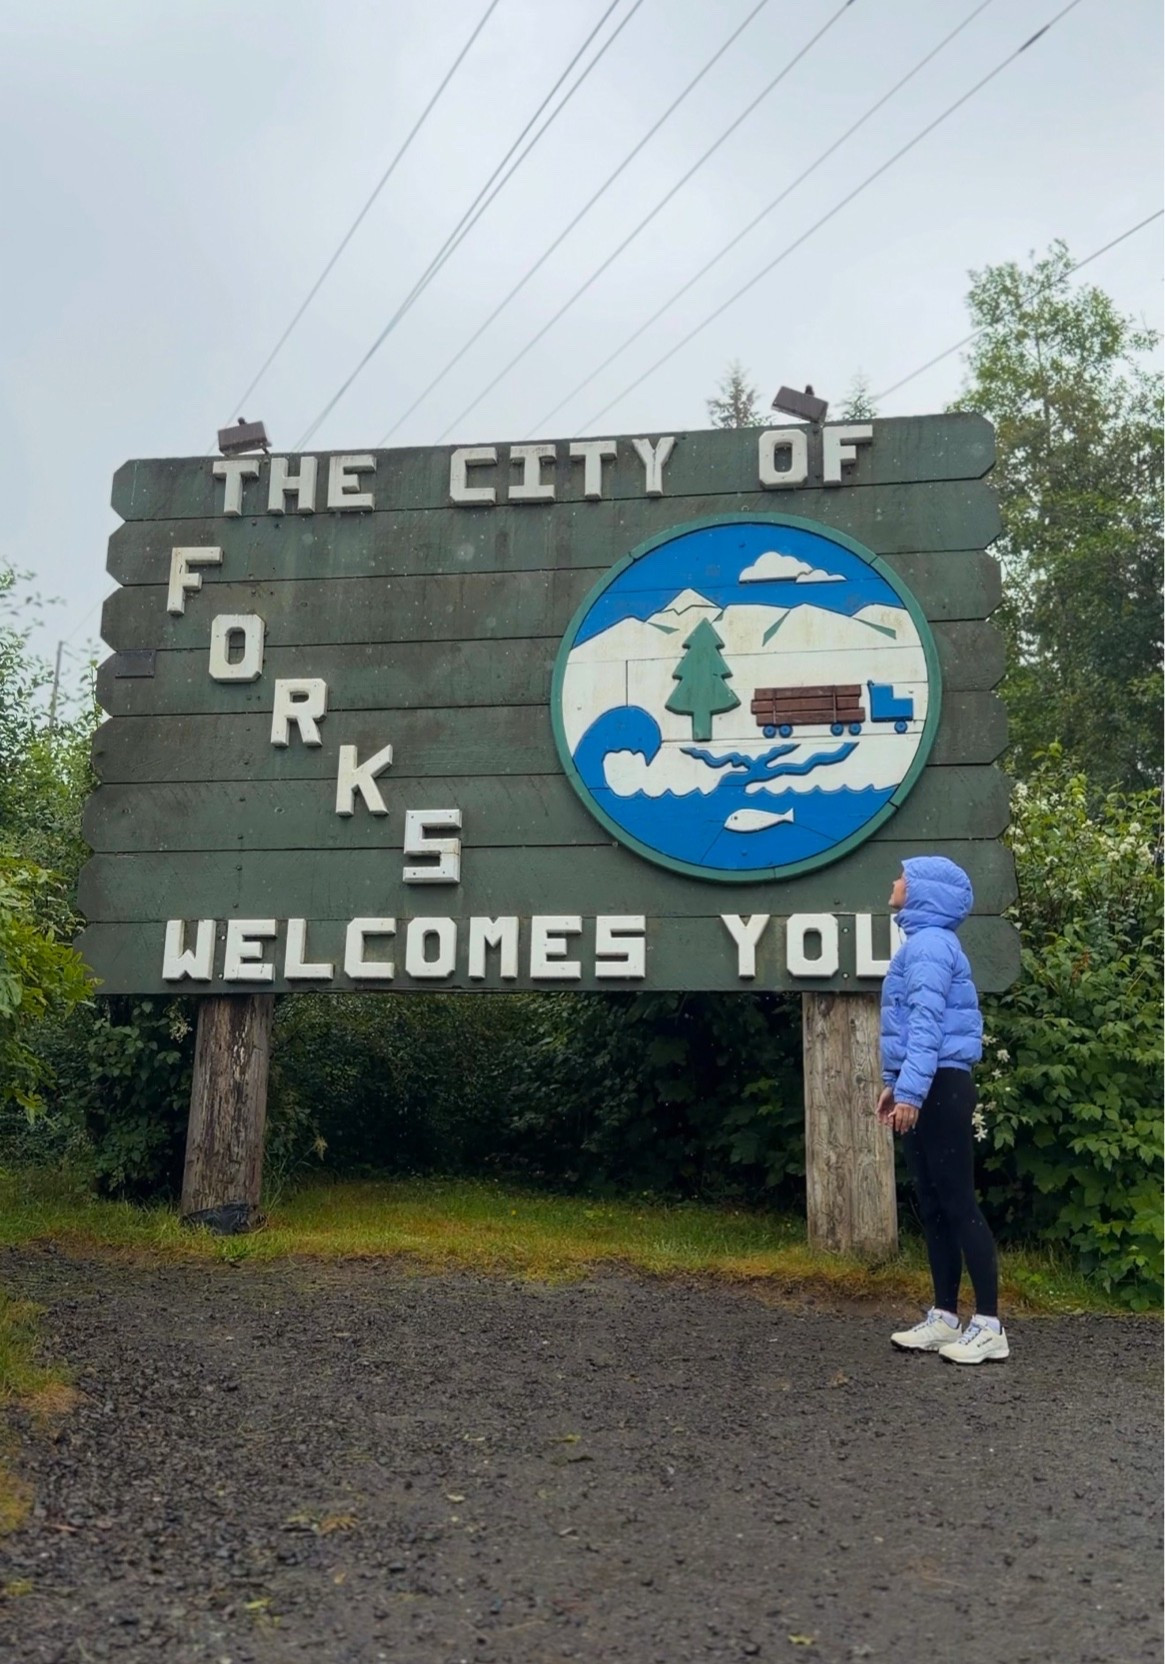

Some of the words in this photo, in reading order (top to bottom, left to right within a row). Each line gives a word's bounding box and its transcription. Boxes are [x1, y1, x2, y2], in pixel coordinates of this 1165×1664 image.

[212, 454, 376, 517] THE
[450, 437, 675, 506] CITY
[758, 424, 873, 489] OF
[167, 547, 462, 883] FORKS
[162, 915, 646, 981] WELCOMES
[720, 913, 907, 979] YOU
